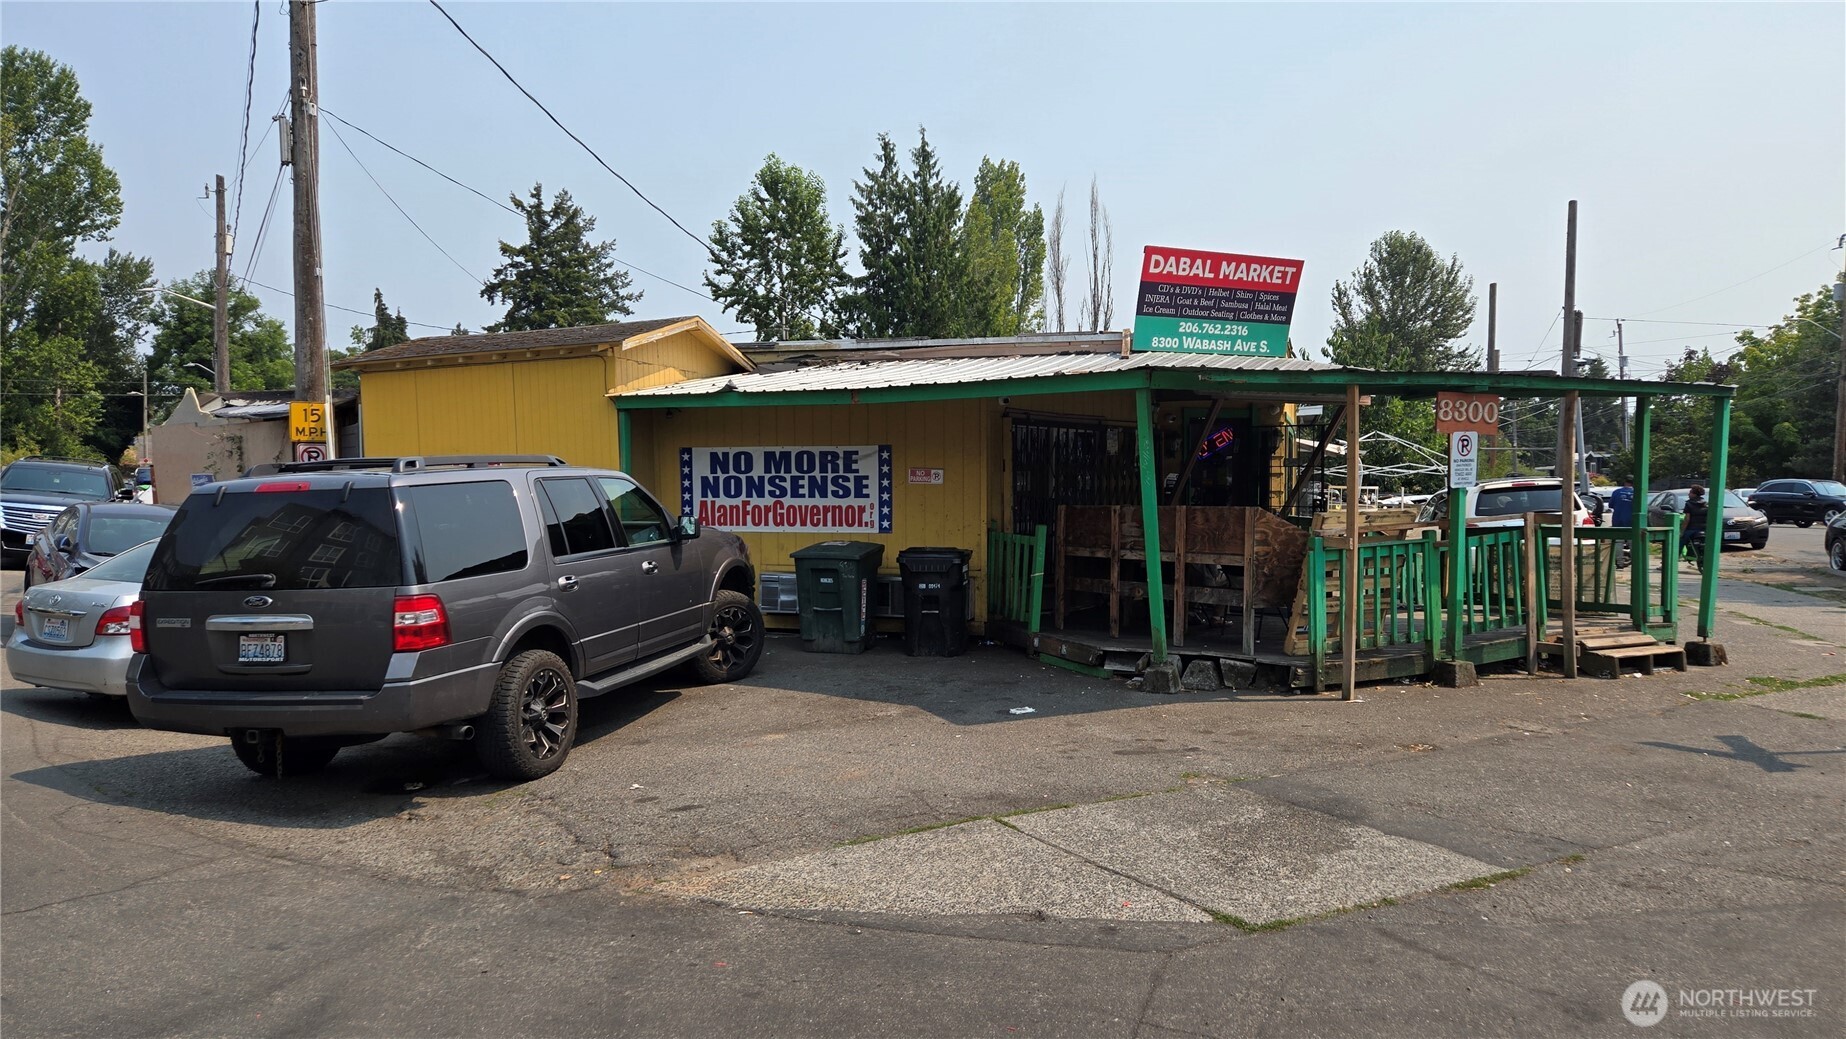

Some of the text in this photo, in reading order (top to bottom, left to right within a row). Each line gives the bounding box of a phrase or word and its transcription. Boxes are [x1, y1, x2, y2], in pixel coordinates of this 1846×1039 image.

[1149, 254, 1297, 285] DABAL MARKET
[1158, 284, 1174, 293] CD's
[1182, 286, 1202, 295] DVD's
[1208, 287, 1230, 297] Helbet
[1235, 290, 1253, 299] Shiro
[1259, 292, 1280, 301] Spices
[1145, 294, 1170, 304] INJERA
[1177, 296, 1192, 305] Goat
[1200, 297, 1215, 306] Beef
[1220, 299, 1249, 309] Sambusa
[1254, 302, 1272, 311] Halal
[1272, 303, 1288, 312] Meat
[1143, 305, 1287, 322] Ice Cream Outdoor Seating Clothes & More
[1178, 321, 1249, 336] 206.762.2316
[1151, 336, 1179, 348] 8300
[1182, 336, 1232, 351] WABASH
[1259, 340, 1270, 353] S.
[303, 408, 321, 423] 15
[1438, 399, 1499, 423] 8300
[709, 450, 860, 475] NO MORE
[700, 474, 871, 499] NONSENSE
[910, 475, 932, 483] PARKING
